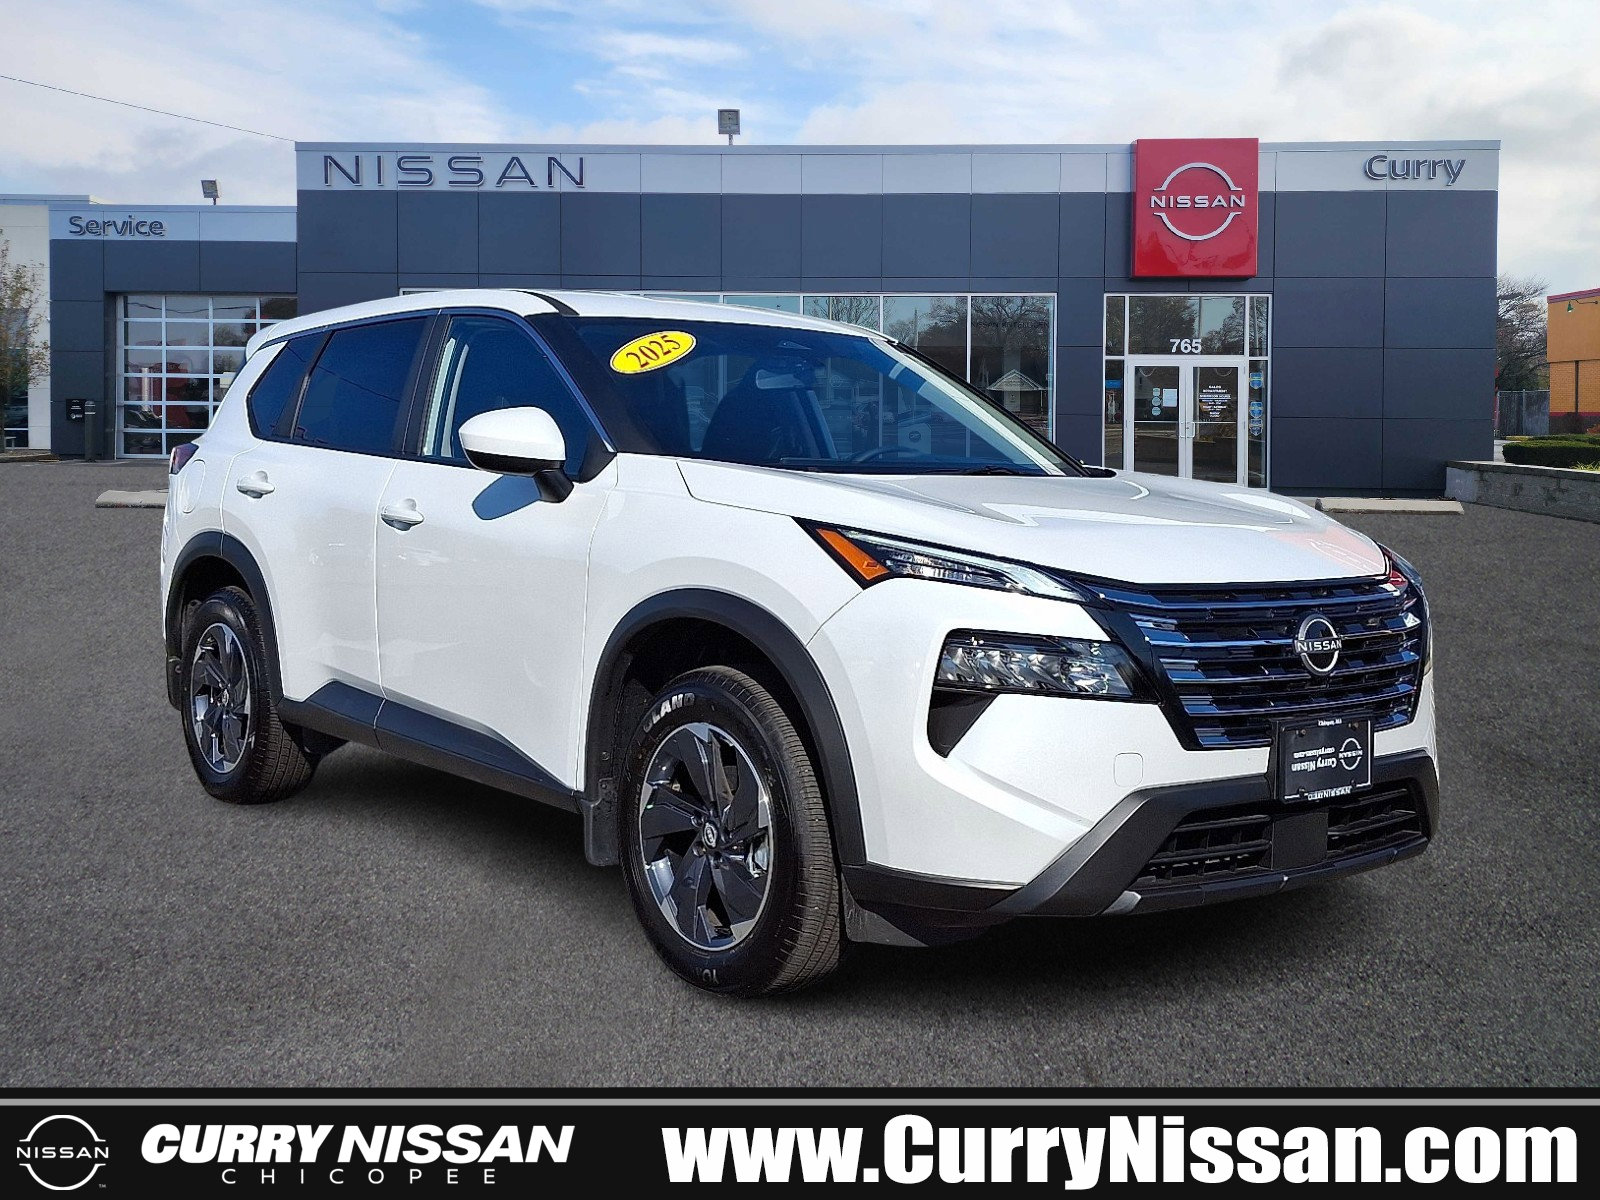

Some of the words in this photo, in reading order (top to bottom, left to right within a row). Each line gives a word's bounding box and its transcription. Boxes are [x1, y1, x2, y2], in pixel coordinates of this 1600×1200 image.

[324, 155, 585, 188] NISSAN
[1365, 154, 1466, 186] Curry
[1151, 194, 1246, 208] NISSAN
[68, 215, 165, 236] Service
[625, 334, 681, 368] 2025
[1169, 338, 1202, 354] 765
[1297, 639, 1343, 652] NISSAN
[1338, 749, 1364, 759] NISSAN
[1291, 760, 1316, 772] Nissan
[1316, 757, 1338, 769] Curry
